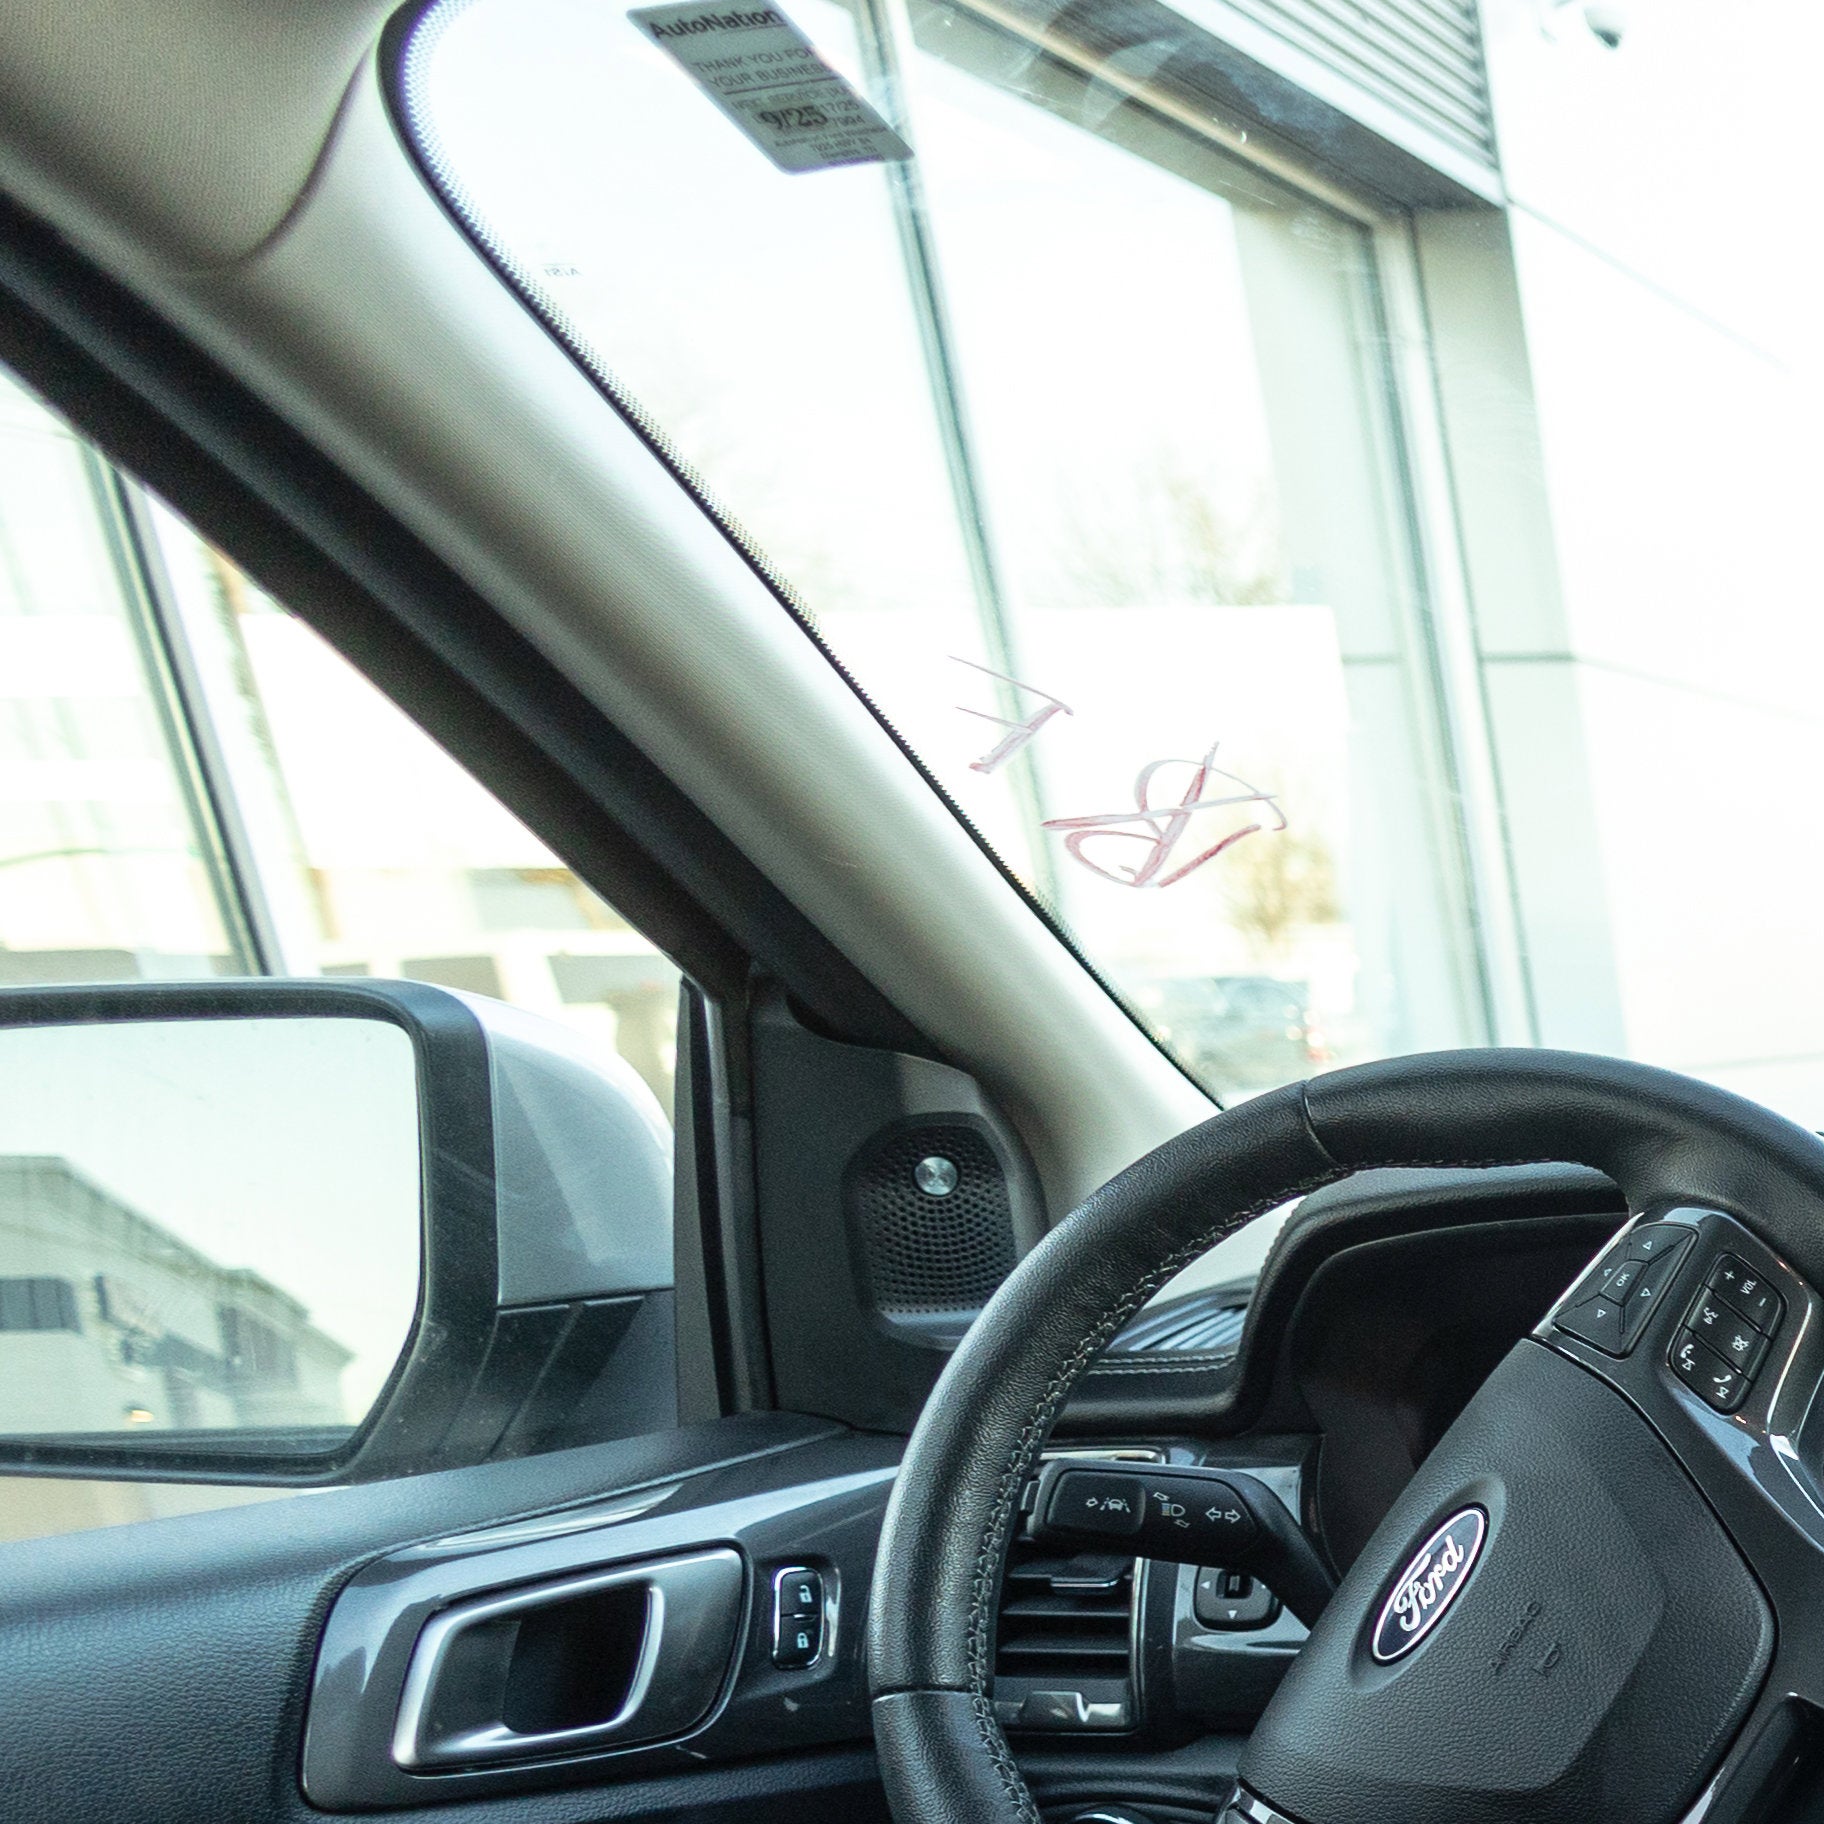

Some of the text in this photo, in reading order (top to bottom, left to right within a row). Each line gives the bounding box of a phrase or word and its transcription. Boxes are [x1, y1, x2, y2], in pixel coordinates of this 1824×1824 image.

[650, 8, 783, 39] AutoNation
[693, 55, 750, 73] THANK
[746, 51, 783, 65] YOU
[709, 72, 756, 87] YOUR
[759, 105, 829, 129] 9/25
[1616, 1272, 1630, 1287] OK
[1740, 1279, 1757, 1295] VOL
